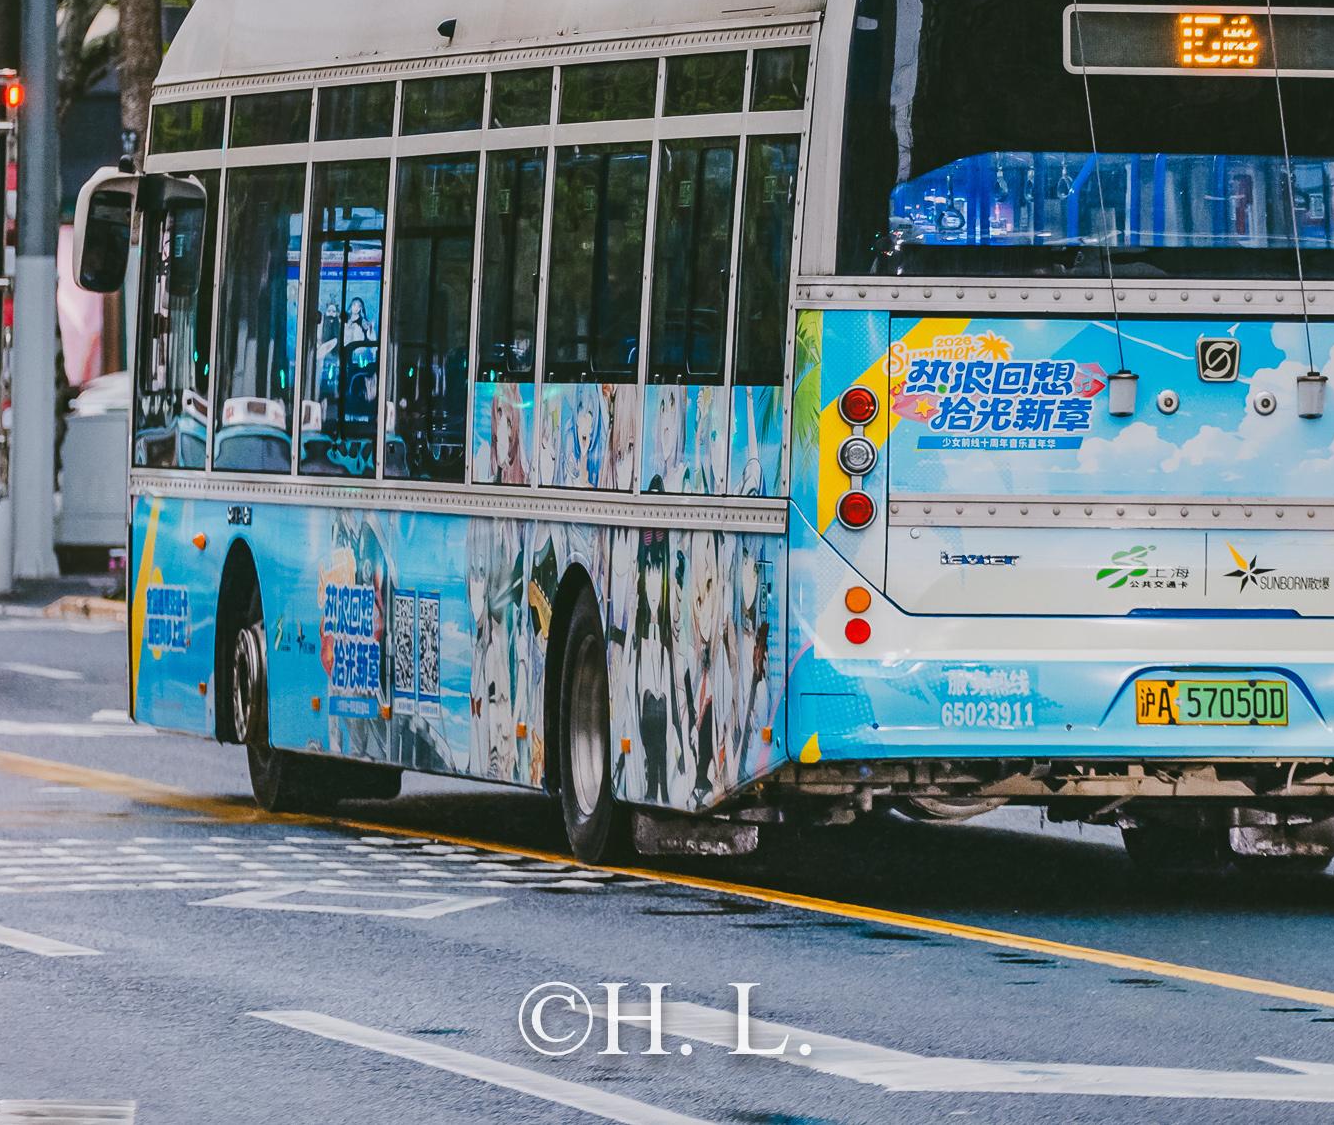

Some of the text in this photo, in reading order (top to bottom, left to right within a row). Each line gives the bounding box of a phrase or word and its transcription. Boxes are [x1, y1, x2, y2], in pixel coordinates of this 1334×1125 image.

[890, 343, 977, 374] Summer
[905, 360, 1075, 395] 热浪回想
[931, 397, 1092, 432] 拾光新章
[942, 437, 1056, 448] 少女前线十周年音乐嘉年华
[1130, 581, 1188, 589] 公共交通卡
[1149, 568, 1189, 578] 上海
[941, 702, 1034, 726] 65023911
